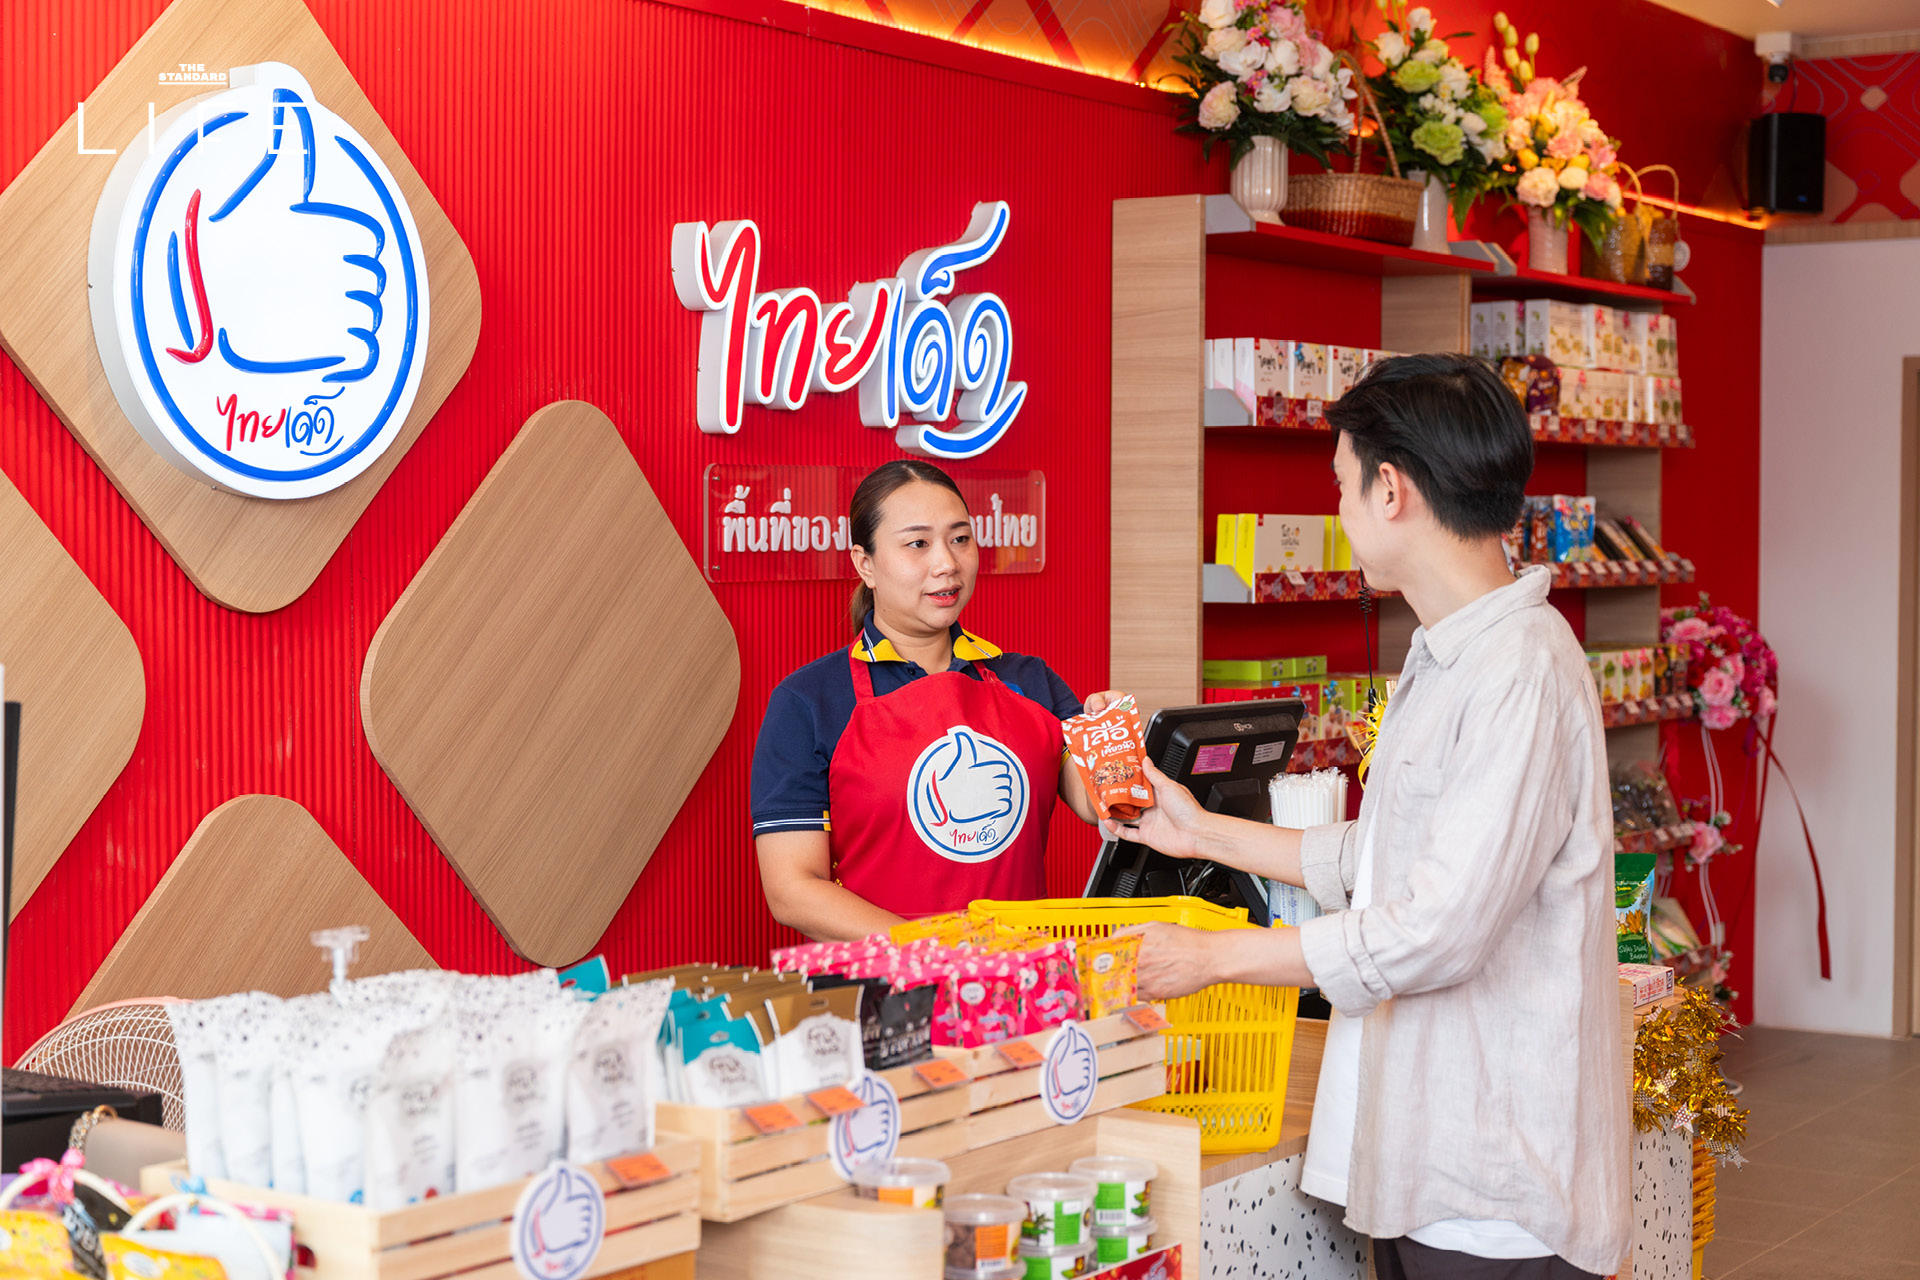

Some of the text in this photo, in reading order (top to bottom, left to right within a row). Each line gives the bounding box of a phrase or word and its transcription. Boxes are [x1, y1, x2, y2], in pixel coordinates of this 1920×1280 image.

[688, 201, 1028, 459] ไทยเด็ด
[216, 386, 345, 457] ไทยเด็ด
[949, 819, 1000, 848] ไทยเด็ด
